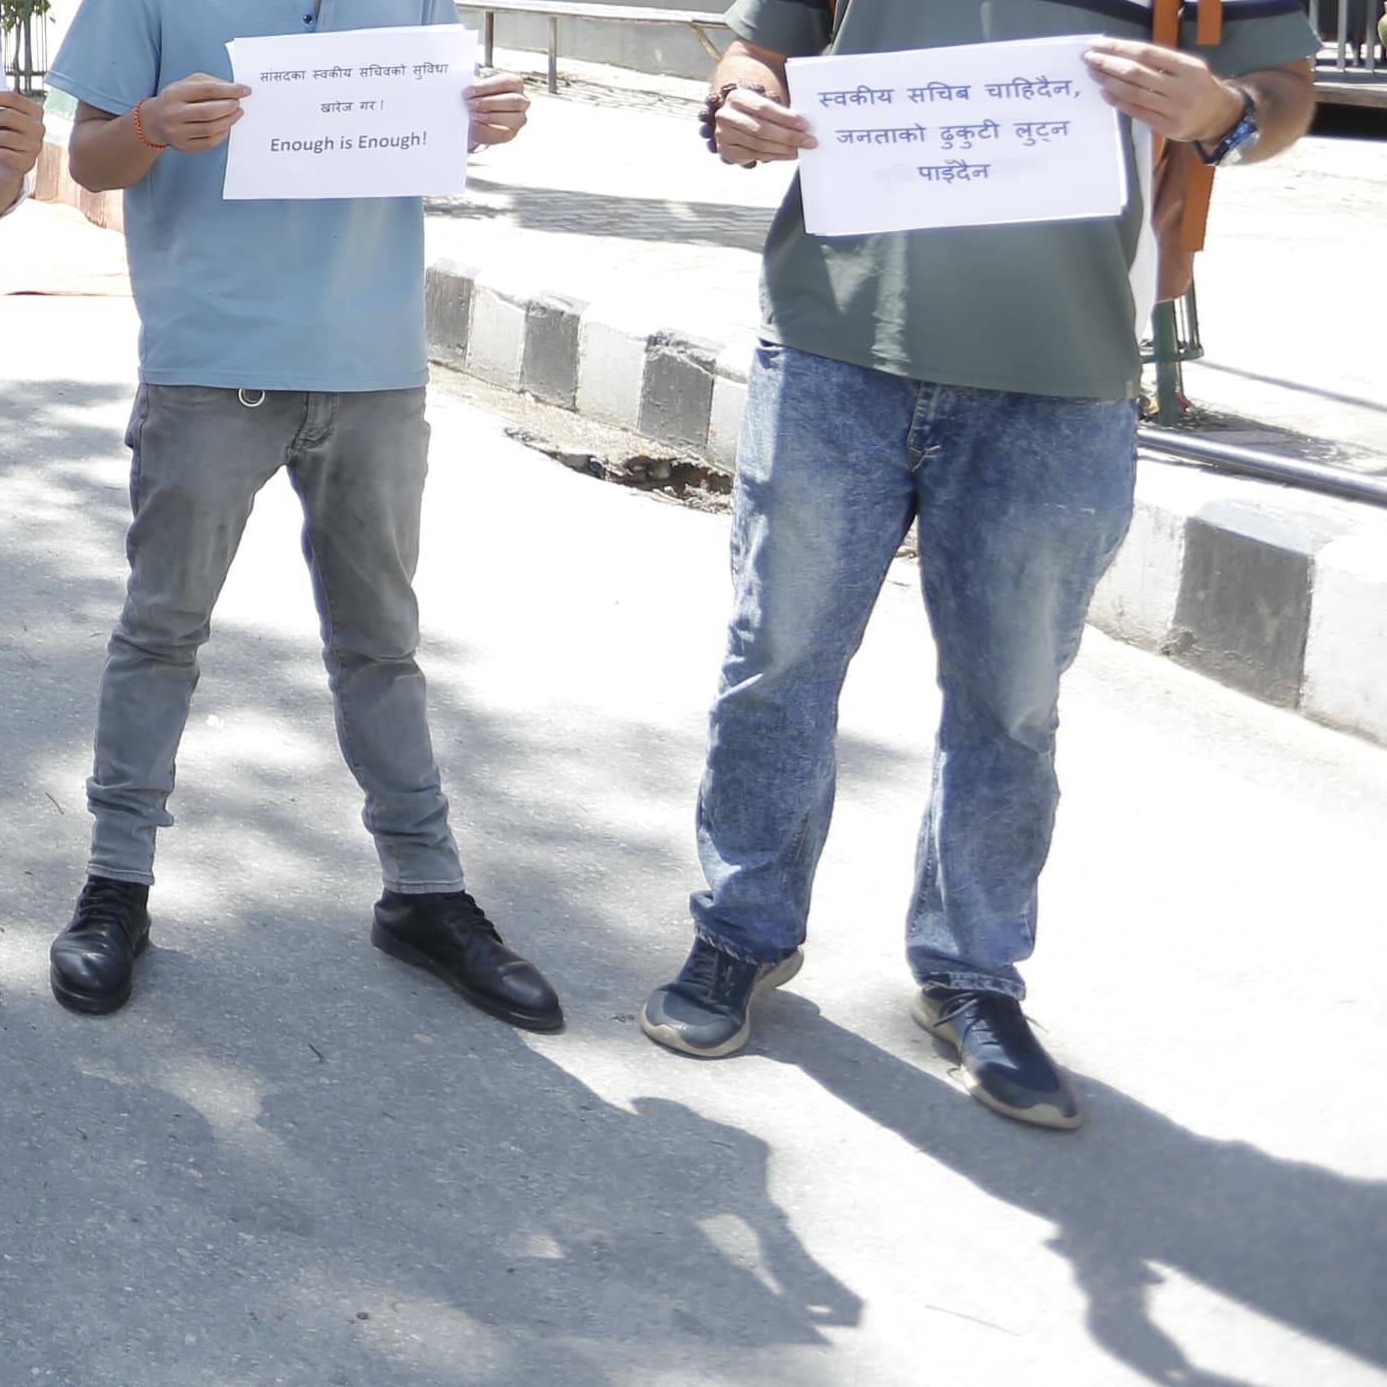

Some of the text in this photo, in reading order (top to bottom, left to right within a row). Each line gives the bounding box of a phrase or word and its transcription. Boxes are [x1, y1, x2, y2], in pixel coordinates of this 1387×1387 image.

[259, 62, 449, 82] सांसदका स्वकीय सचिवको सुविधा
[817, 75, 1080, 107] स्वकीय सचिब चाहिदैन,
[321, 100, 354, 113] खारेज
[271, 131, 426, 154] Enough is Enough!
[835, 119, 1071, 150] जनताको ढुकुटी लुट्न
